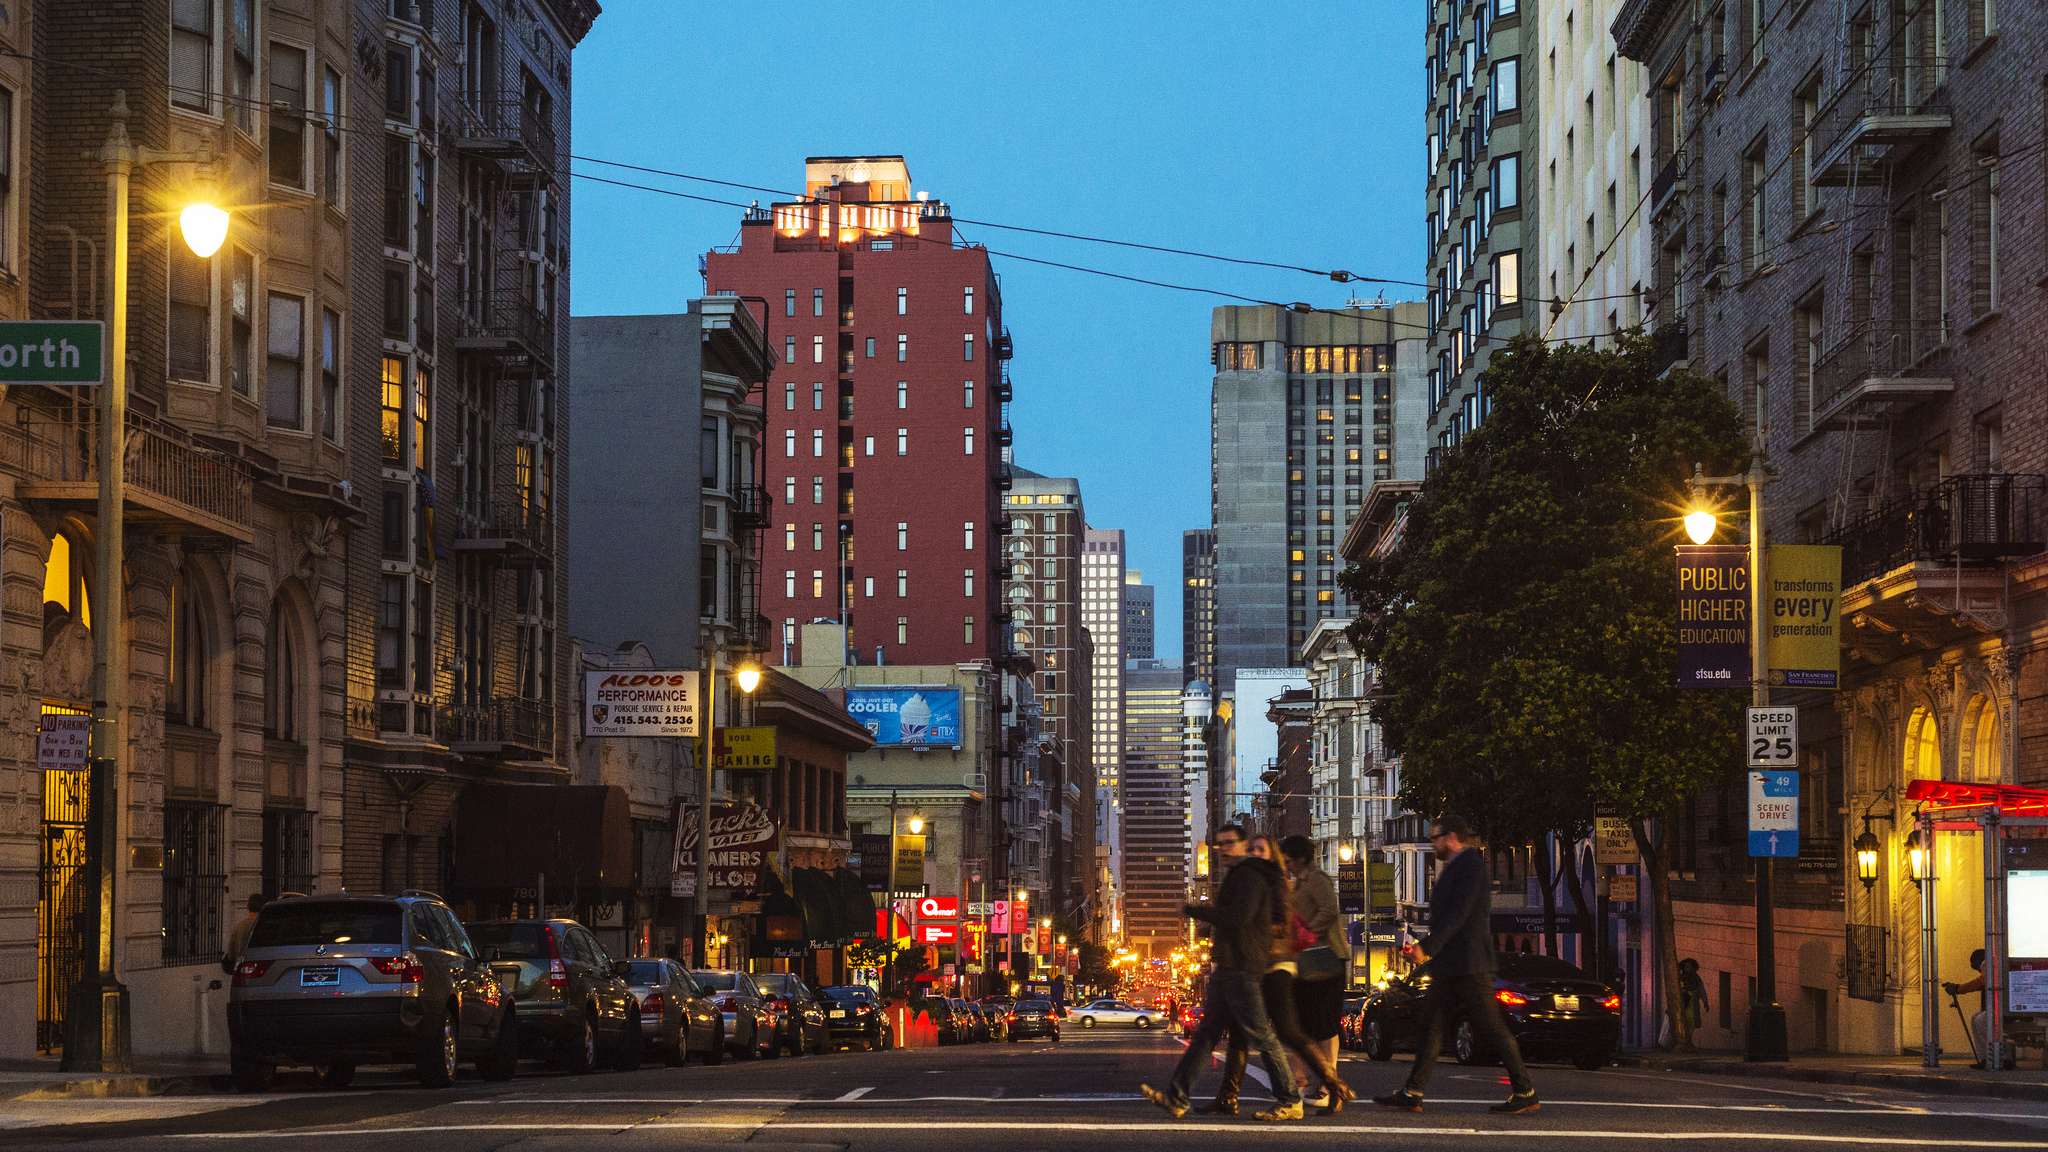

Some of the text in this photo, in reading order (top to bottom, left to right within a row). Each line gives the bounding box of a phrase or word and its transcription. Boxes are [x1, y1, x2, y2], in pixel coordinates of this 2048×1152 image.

[0, 338, 80, 368] orth
[1680, 568, 1746, 591] PUBLIC
[1774, 579, 1834, 592] transforms
[1680, 599, 1746, 621] HIGHER
[1774, 597, 1834, 622] every
[1680, 628, 1746, 644] EDUCATION
[1772, 623, 1832, 638] generation
[1695, 668, 1731, 679] sfsu.edu
[600, 674, 684, 688] ALDO'S
[598, 690, 686, 702] PERFORMANCE
[614, 704, 693, 712] PORSCHE SERVICE & REPAIR
[848, 703, 898, 712] COOLER
[42, 716, 56, 730] NO
[1752, 714, 1793, 722] SPEED
[58, 720, 88, 731] PARKING
[1756, 726, 1788, 736] LIMIT
[42, 748, 84, 758] MON WED FRI
[1752, 738, 1793, 760] 25
[1776, 776, 1790, 786] 49
[712, 832, 762, 846] VALET
[1606, 840, 1628, 848] ONLY
[862, 843, 889, 854] PUBLIC
[898, 848, 922, 856] serves
[680, 851, 760, 866] CLANERS
[1340, 871, 1364, 880] PUBLIC
[1340, 882, 1364, 890] HIGHER
[512, 888, 536, 898] 780
[1516, 916, 1544, 924] Vantaggi
[966, 924, 988, 932] THAI
